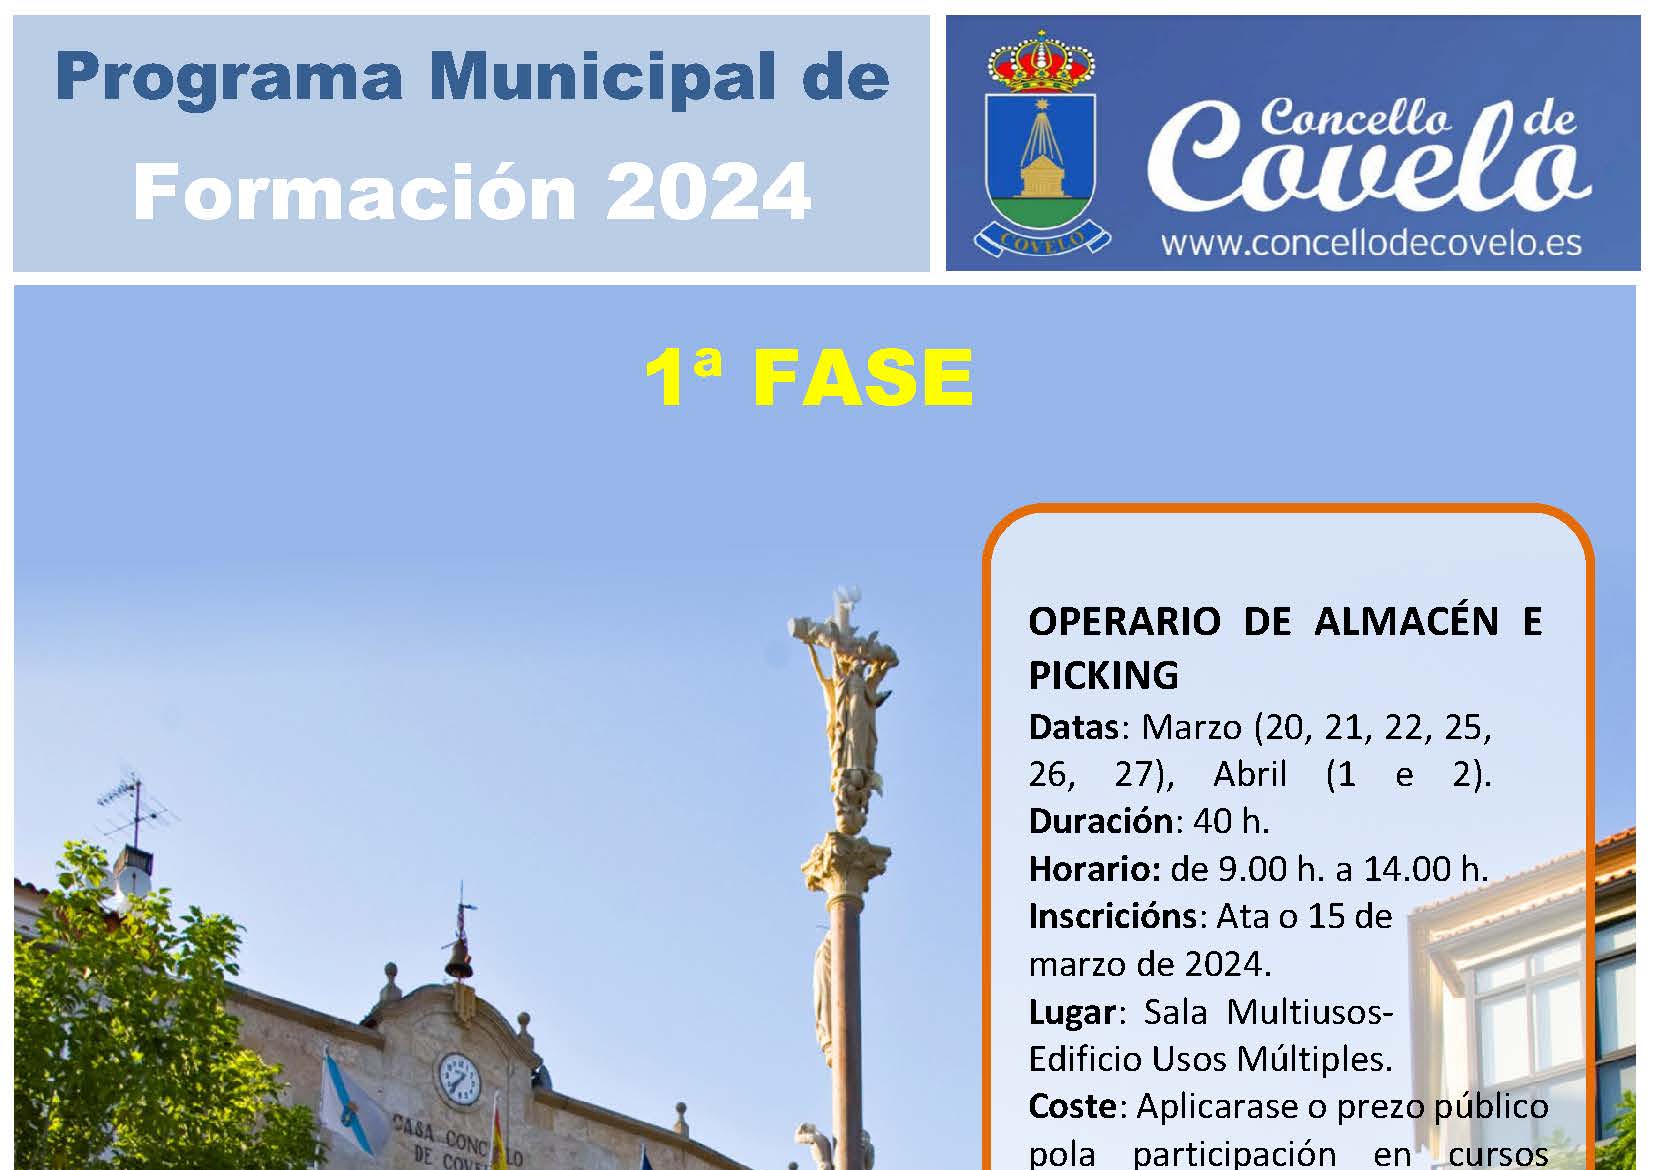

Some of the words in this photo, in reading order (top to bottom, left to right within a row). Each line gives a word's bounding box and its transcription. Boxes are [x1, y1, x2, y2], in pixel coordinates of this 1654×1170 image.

[58, 51, 402, 113] Programa
[432, 51, 774, 112] Municipal
[803, 51, 889, 100] de
[1260, 97, 1453, 136] Concello
[1523, 97, 1578, 136] de
[1147, 100, 1593, 213] Covelo
[136, 162, 574, 220] Formación
[607, 162, 811, 220] 2024
[1000, 231, 1085, 254] COVELO
[1162, 228, 1582, 255] www.concellodecovelo.es
[647, 348, 720, 405] 1ª
[756, 348, 972, 406] FASE
[1030, 607, 1220, 635] OPERARIO
[1246, 607, 1291, 635] DE
[1315, 599, 1497, 635] ALMACÉN
[1525, 607, 1542, 635] E
[1031, 661, 1177, 689] PICKING
[1031, 714, 1128, 739] Datas:
[1144, 714, 1241, 739] Marzo
[1256, 712, 1311, 746] (20,
[1326, 714, 1371, 745] 21,
[1386, 714, 1431, 745] 22,
[1446, 714, 1490, 745] 25,
[1030, 761, 1074, 792] 26,
[1116, 759, 1173, 793] 27),
[1214, 759, 1285, 786] Abril
[1328, 759, 1355, 793] (1
[1397, 768, 1413, 786] e
[1454, 759, 1490, 793] 2).
[1031, 806, 1182, 833] Duración:
[1194, 808, 1231, 833] 40
[1244, 806, 1268, 833] h.
[1031, 855, 1159, 881] Horario:
[1172, 855, 1208, 881] de
[1220, 856, 1286, 881] 9.00
[1299, 854, 1323, 881] h.
[1337, 863, 1351, 881] a
[1366, 856, 1450, 881] 14.00
[1463, 854, 1487, 881] h.
[1031, 901, 1206, 928] Inscricións:
[1217, 903, 1268, 928] Ata
[1280, 910, 1297, 928] o
[1310, 903, 1344, 928] 15
[1356, 902, 1392, 928] de
[1031, 958, 1125, 976] marzo
[1138, 950, 1174, 976] de
[1186, 951, 1270, 976] 2024.
[1031, 999, 1125, 1031] Lugar:
[1145, 997, 1206, 1024] Sala
[1229, 997, 1393, 1024] Multiusos-
[1031, 1044, 1141, 1071] Edificio
[1154, 1046, 1226, 1071] Usos
[1239, 1044, 1391, 1078] Múltiples.
[1030, 1093, 1126, 1118] Coste:
[1137, 1091, 1298, 1125] Aplicarase
[1309, 1100, 1326, 1118] o
[1339, 1100, 1424, 1125] prezo
[1436, 1091, 1548, 1125] público
[392, 1113, 434, 1143] CASA
[446, 1129, 524, 1168] CONCLO
[415, 1144, 433, 1166] DE
[1375, 1148, 1410, 1166] en
[1450, 1148, 1548, 1166] cursos
